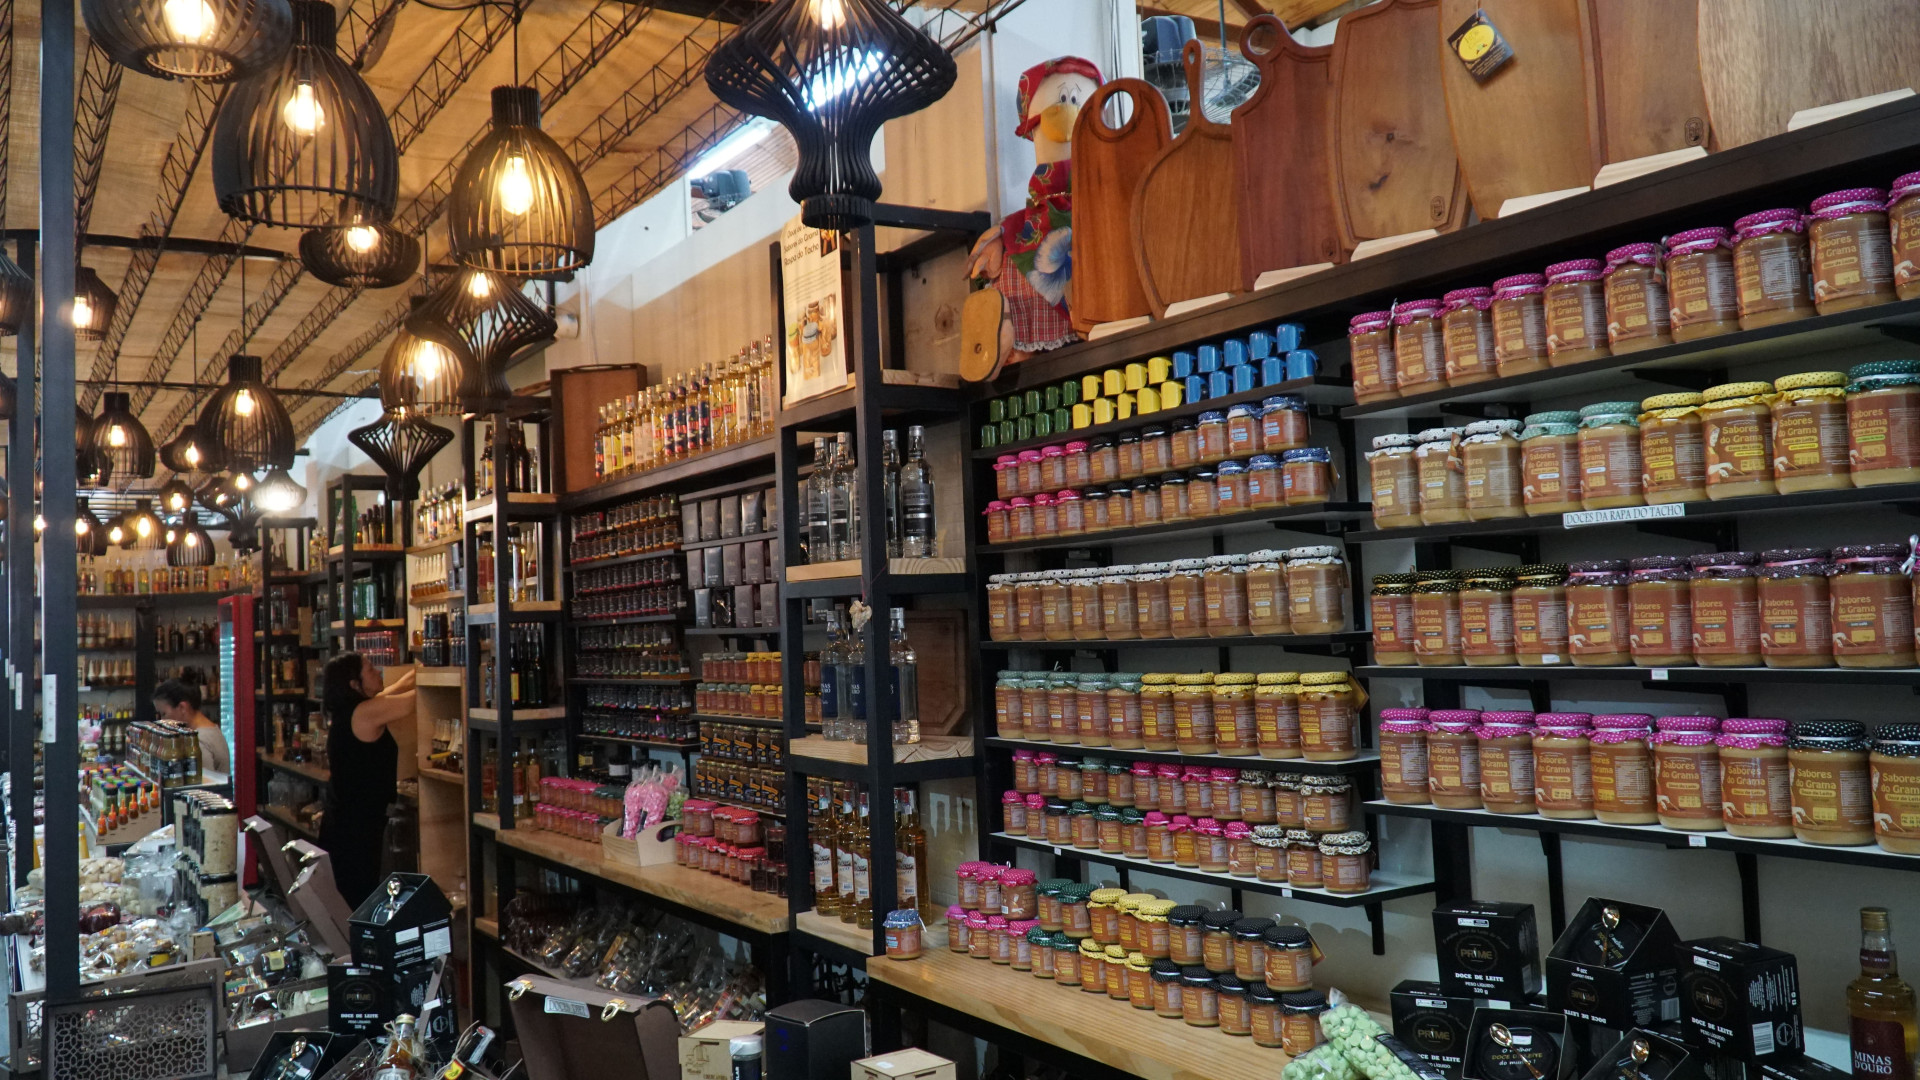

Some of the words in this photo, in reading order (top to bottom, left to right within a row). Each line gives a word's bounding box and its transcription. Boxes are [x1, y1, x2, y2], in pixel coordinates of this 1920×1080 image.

[804, 242, 820, 256] Tacho
[1826, 245, 1857, 258] Grama
[1679, 276, 1705, 288] Grama
[1618, 291, 1644, 303] Grama
[1779, 417, 1813, 428] Sabores
[1858, 418, 1887, 429] Grama
[1722, 425, 1759, 435] Sabores
[1788, 426, 1817, 436] Grama
[1720, 435, 1730, 444] do
[1733, 433, 1763, 443] Grama
[1649, 445, 1673, 455] Grama
[1529, 452, 1556, 461] Sabores
[1535, 459, 1560, 468] Grama
[1566, 512, 1595, 526] DOCES
[1594, 511, 1608, 522] DA
[1609, 508, 1633, 521] RAPA
[1633, 506, 1648, 518] DO
[1649, 504, 1683, 518] TACHO
[1765, 599, 1794, 607] Sabores
[1839, 596, 1871, 605] Sabores
[1579, 602, 1607, 611] Sabores
[1633, 603, 1661, 611] Sabores
[1772, 607, 1798, 616] Grama
[1847, 604, 1876, 614] Grama
[1466, 613, 1486, 622] Grama
[1586, 610, 1611, 619] Grama
[1640, 610, 1664, 619] Grama
[1702, 608, 1727, 617] Grama
[1420, 616, 1442, 624] Grama
[1436, 754, 1459, 763] Grama
[1539, 756, 1567, 764] Sabores
[1486, 760, 1508, 768] Grama
[1546, 765, 1571, 773] Grama
[1663, 761, 1695, 770] Sabores
[1662, 770, 1671, 779] do
[1671, 771, 1700, 780] Grama
[1728, 766, 1761, 776] Sabores
[1797, 768, 1832, 779] Sabores
[1727, 776, 1735, 785] do
[1736, 776, 1766, 786] Grama
[1796, 779, 1804, 788] do
[1805, 779, 1837, 790] Grama
[1881, 784, 1891, 793] do
[1892, 784, 1920, 795] Gram
[1460, 947, 1493, 961] PRIME
[1455, 972, 1473, 980] DOCE
[1486, 975, 1504, 983] LEITE
[1564, 1009, 1580, 1018] LEITE
[1591, 1015, 1607, 1024] DOCE
[1691, 1016, 1707, 1028] DOCE
[1708, 1022, 1716, 1030] DE
[1717, 1025, 1734, 1037] LEITE
[1418, 1028, 1451, 1041] PRIME
[1854, 1050, 1892, 1066] MINAS
[1854, 1060, 1893, 1075] D'OURO
